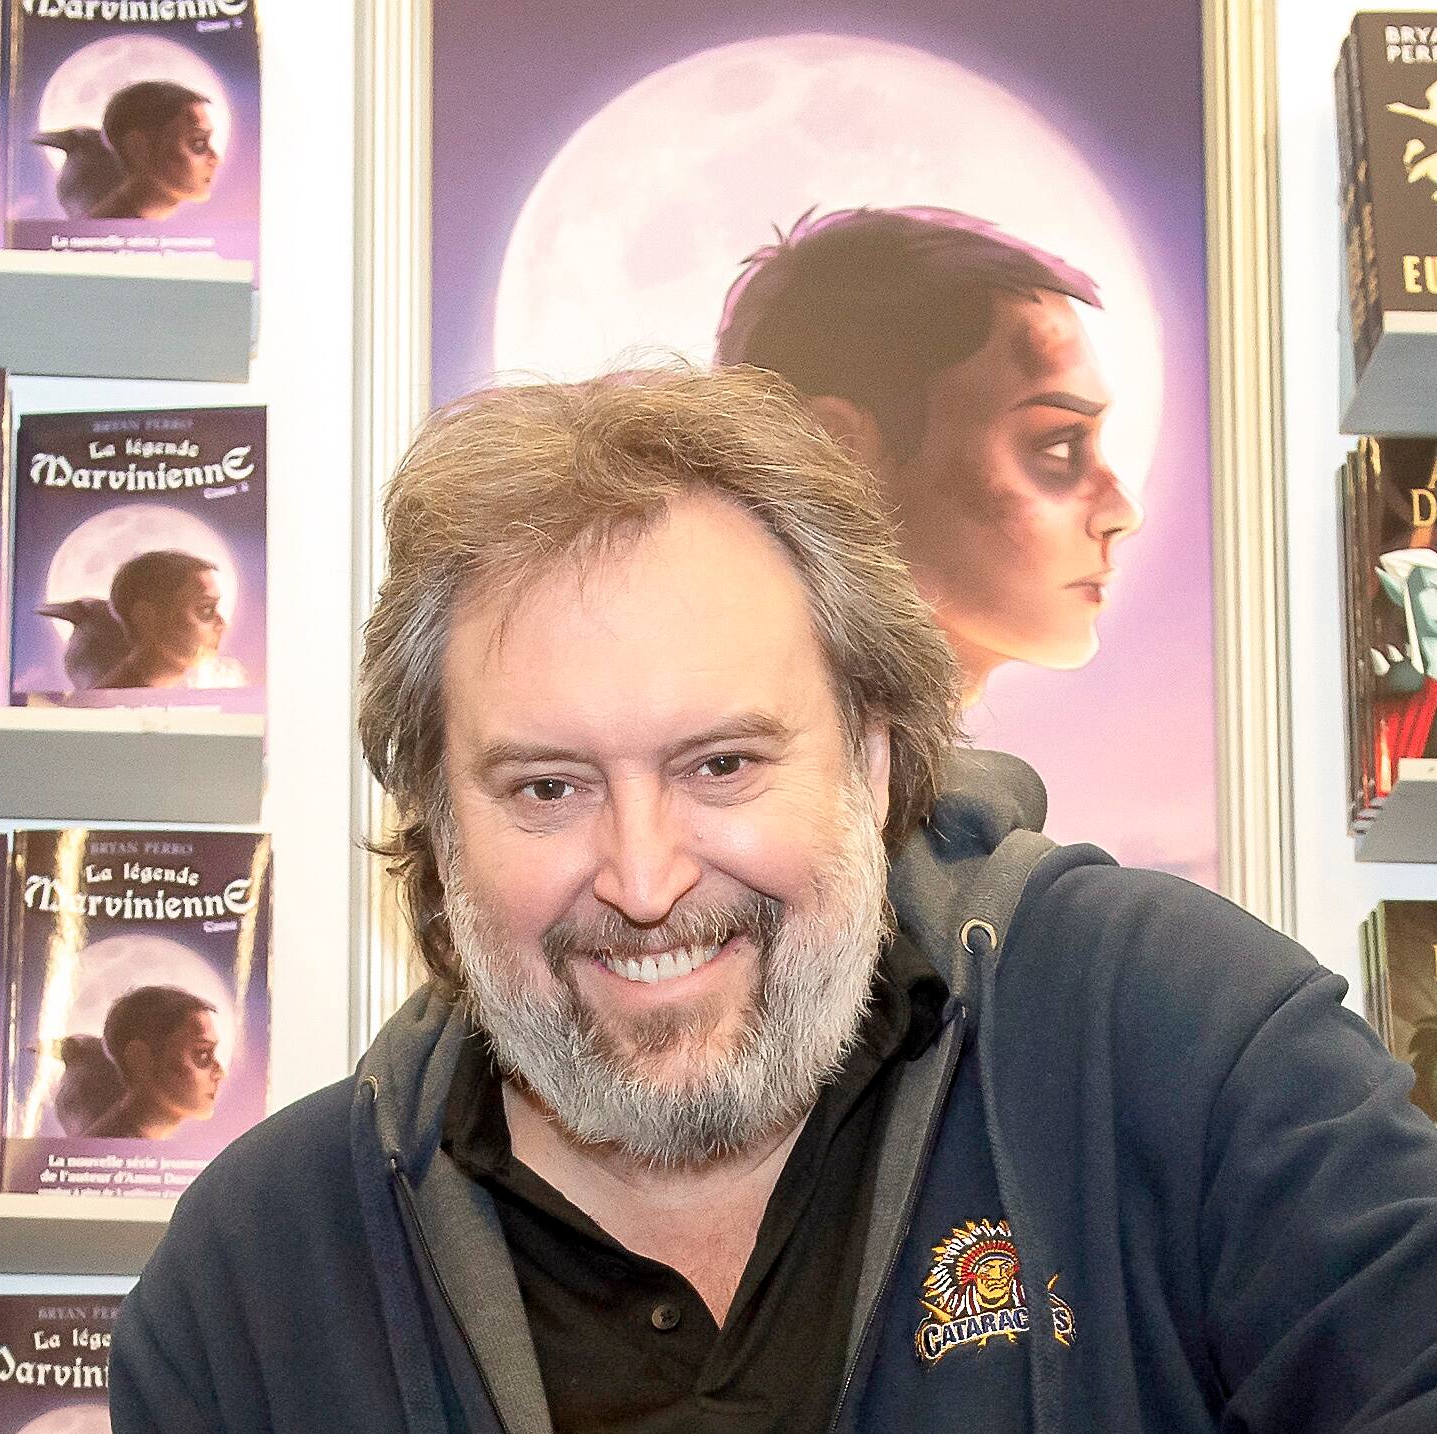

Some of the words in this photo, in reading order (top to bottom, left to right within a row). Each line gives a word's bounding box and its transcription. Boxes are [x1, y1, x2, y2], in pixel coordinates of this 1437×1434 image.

[89, 441, 115, 459] La
[86, 866, 112, 883] La
[34, 1331, 60, 1350] La
[923, 1307, 1072, 1359] CATARACS
